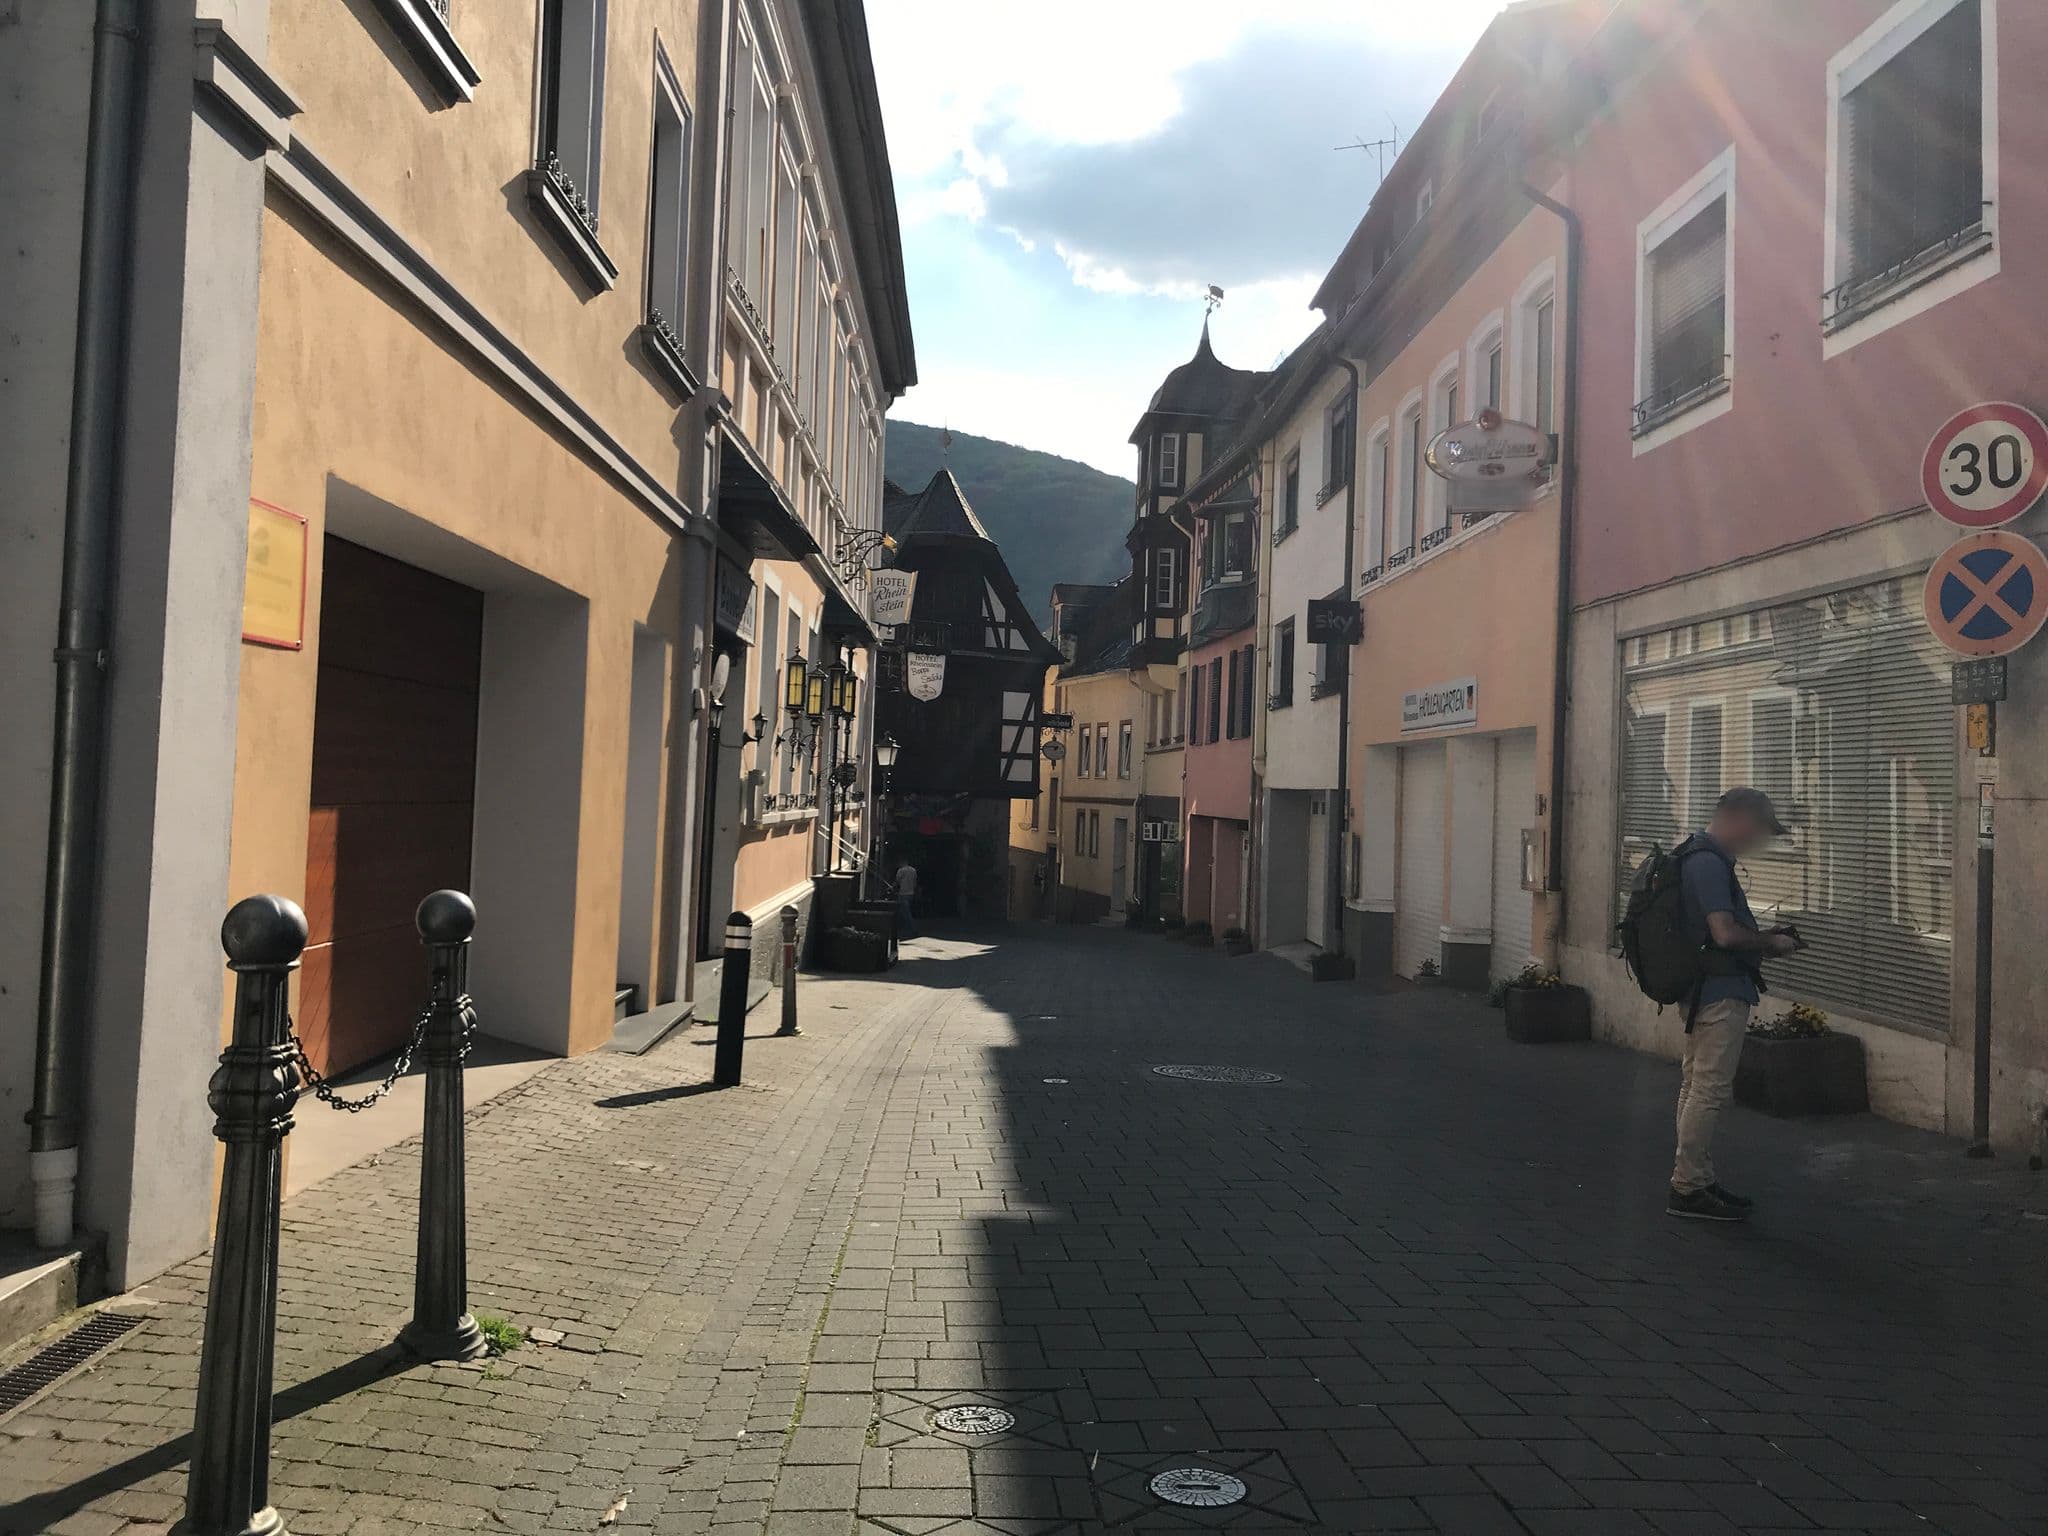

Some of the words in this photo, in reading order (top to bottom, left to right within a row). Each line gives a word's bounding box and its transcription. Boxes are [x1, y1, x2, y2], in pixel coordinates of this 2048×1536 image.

[1949, 434, 2022, 496] 30
[877, 577, 906, 588] HOTEL
[874, 586, 907, 602] Rhein
[877, 600, 904, 613] stein
[1315, 610, 1354, 633] sky
[915, 655, 938, 663] HOTEL
[1419, 688, 1465, 717] HÖLLENGARTEN
